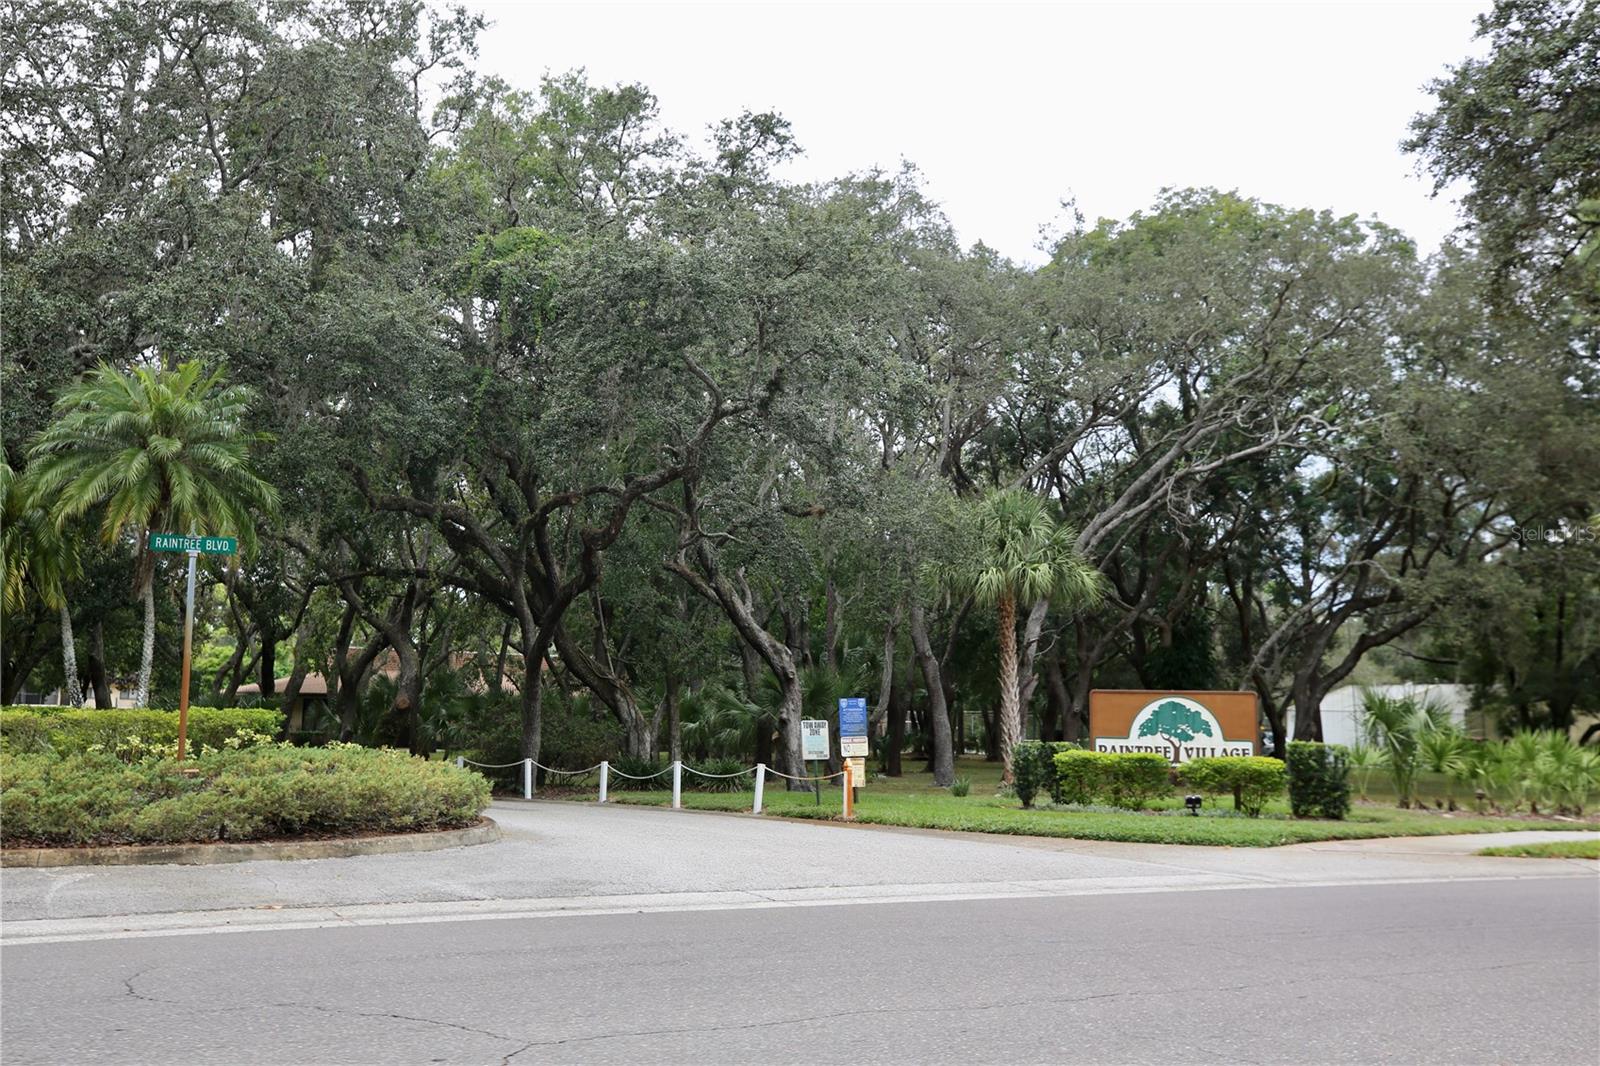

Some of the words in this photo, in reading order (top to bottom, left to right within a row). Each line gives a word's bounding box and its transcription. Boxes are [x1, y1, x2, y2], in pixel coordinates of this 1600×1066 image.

[155, 537, 201, 550] RAINTREE
[206, 540, 231, 551] BLVD.
[803, 721, 813, 729] TOW
